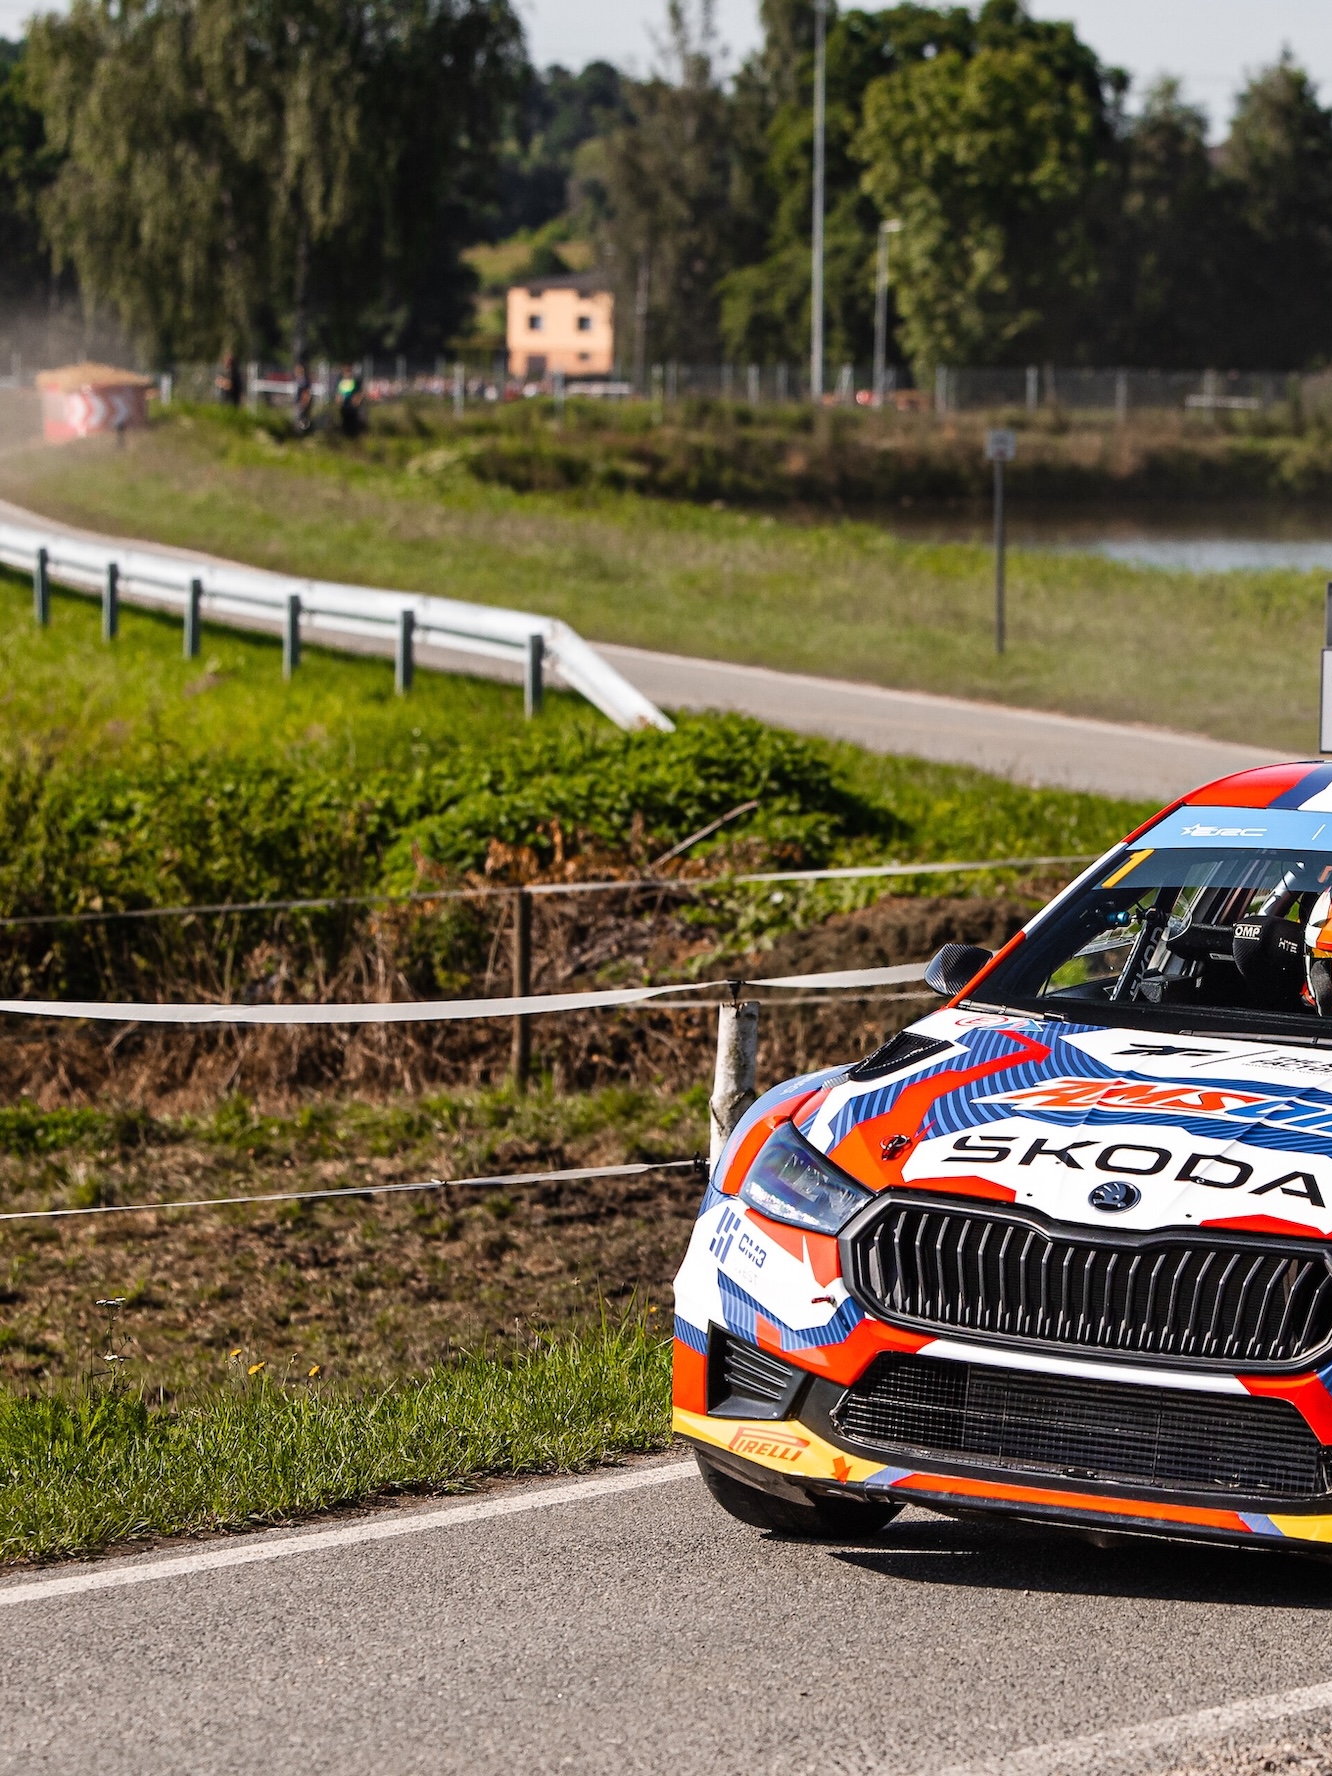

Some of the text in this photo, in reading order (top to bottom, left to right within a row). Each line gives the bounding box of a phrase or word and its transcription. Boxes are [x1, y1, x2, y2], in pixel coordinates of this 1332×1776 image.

[1101, 849, 1155, 888] 1
[1234, 924, 1262, 939] OMP
[1278, 938, 1298, 954] HTE
[941, 1135, 1326, 1208] SKODA
[738, 1232, 768, 1269] CM3
[727, 1426, 811, 1463] PIRELLI
